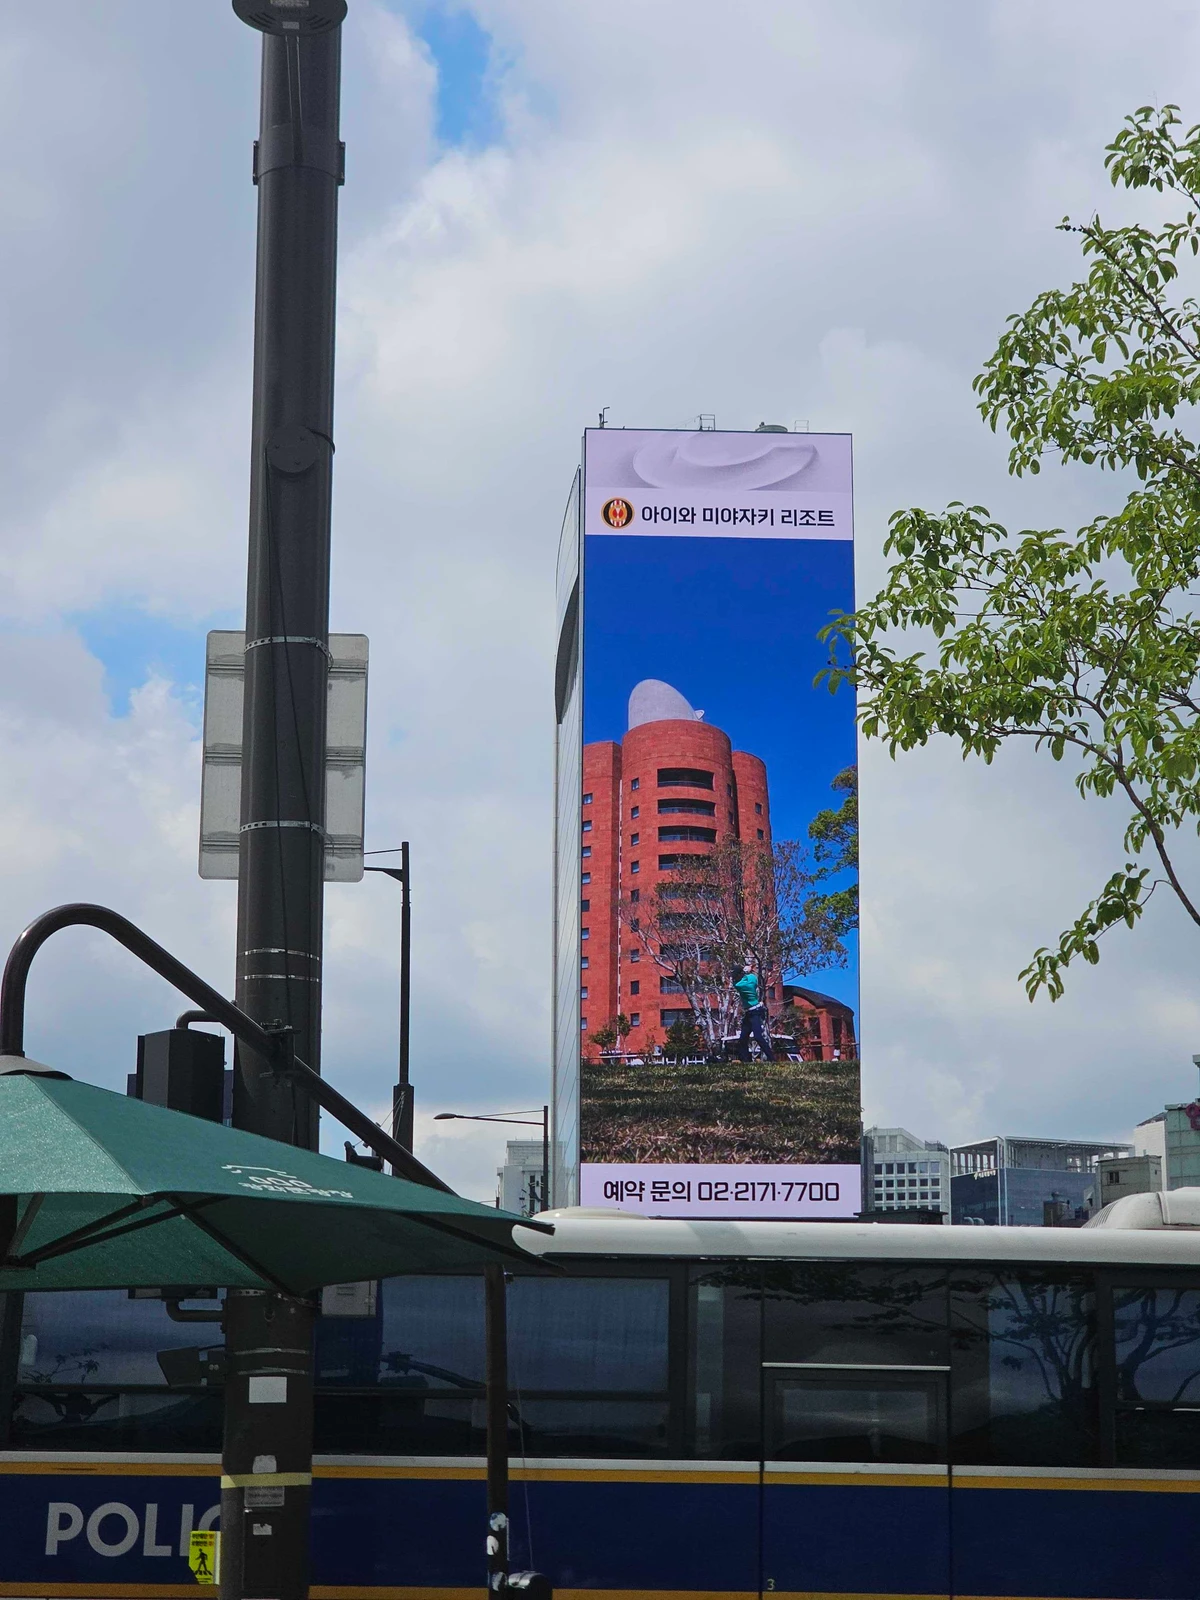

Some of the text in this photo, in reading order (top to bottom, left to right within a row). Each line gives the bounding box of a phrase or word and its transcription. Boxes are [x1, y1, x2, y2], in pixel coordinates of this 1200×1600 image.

[641, 505, 835, 527] 아이와 미야자키 리조트
[603, 1180, 645, 1202] 예약
[650, 1180, 691, 1202] 문의
[767, 1578, 775, 1591] 3
